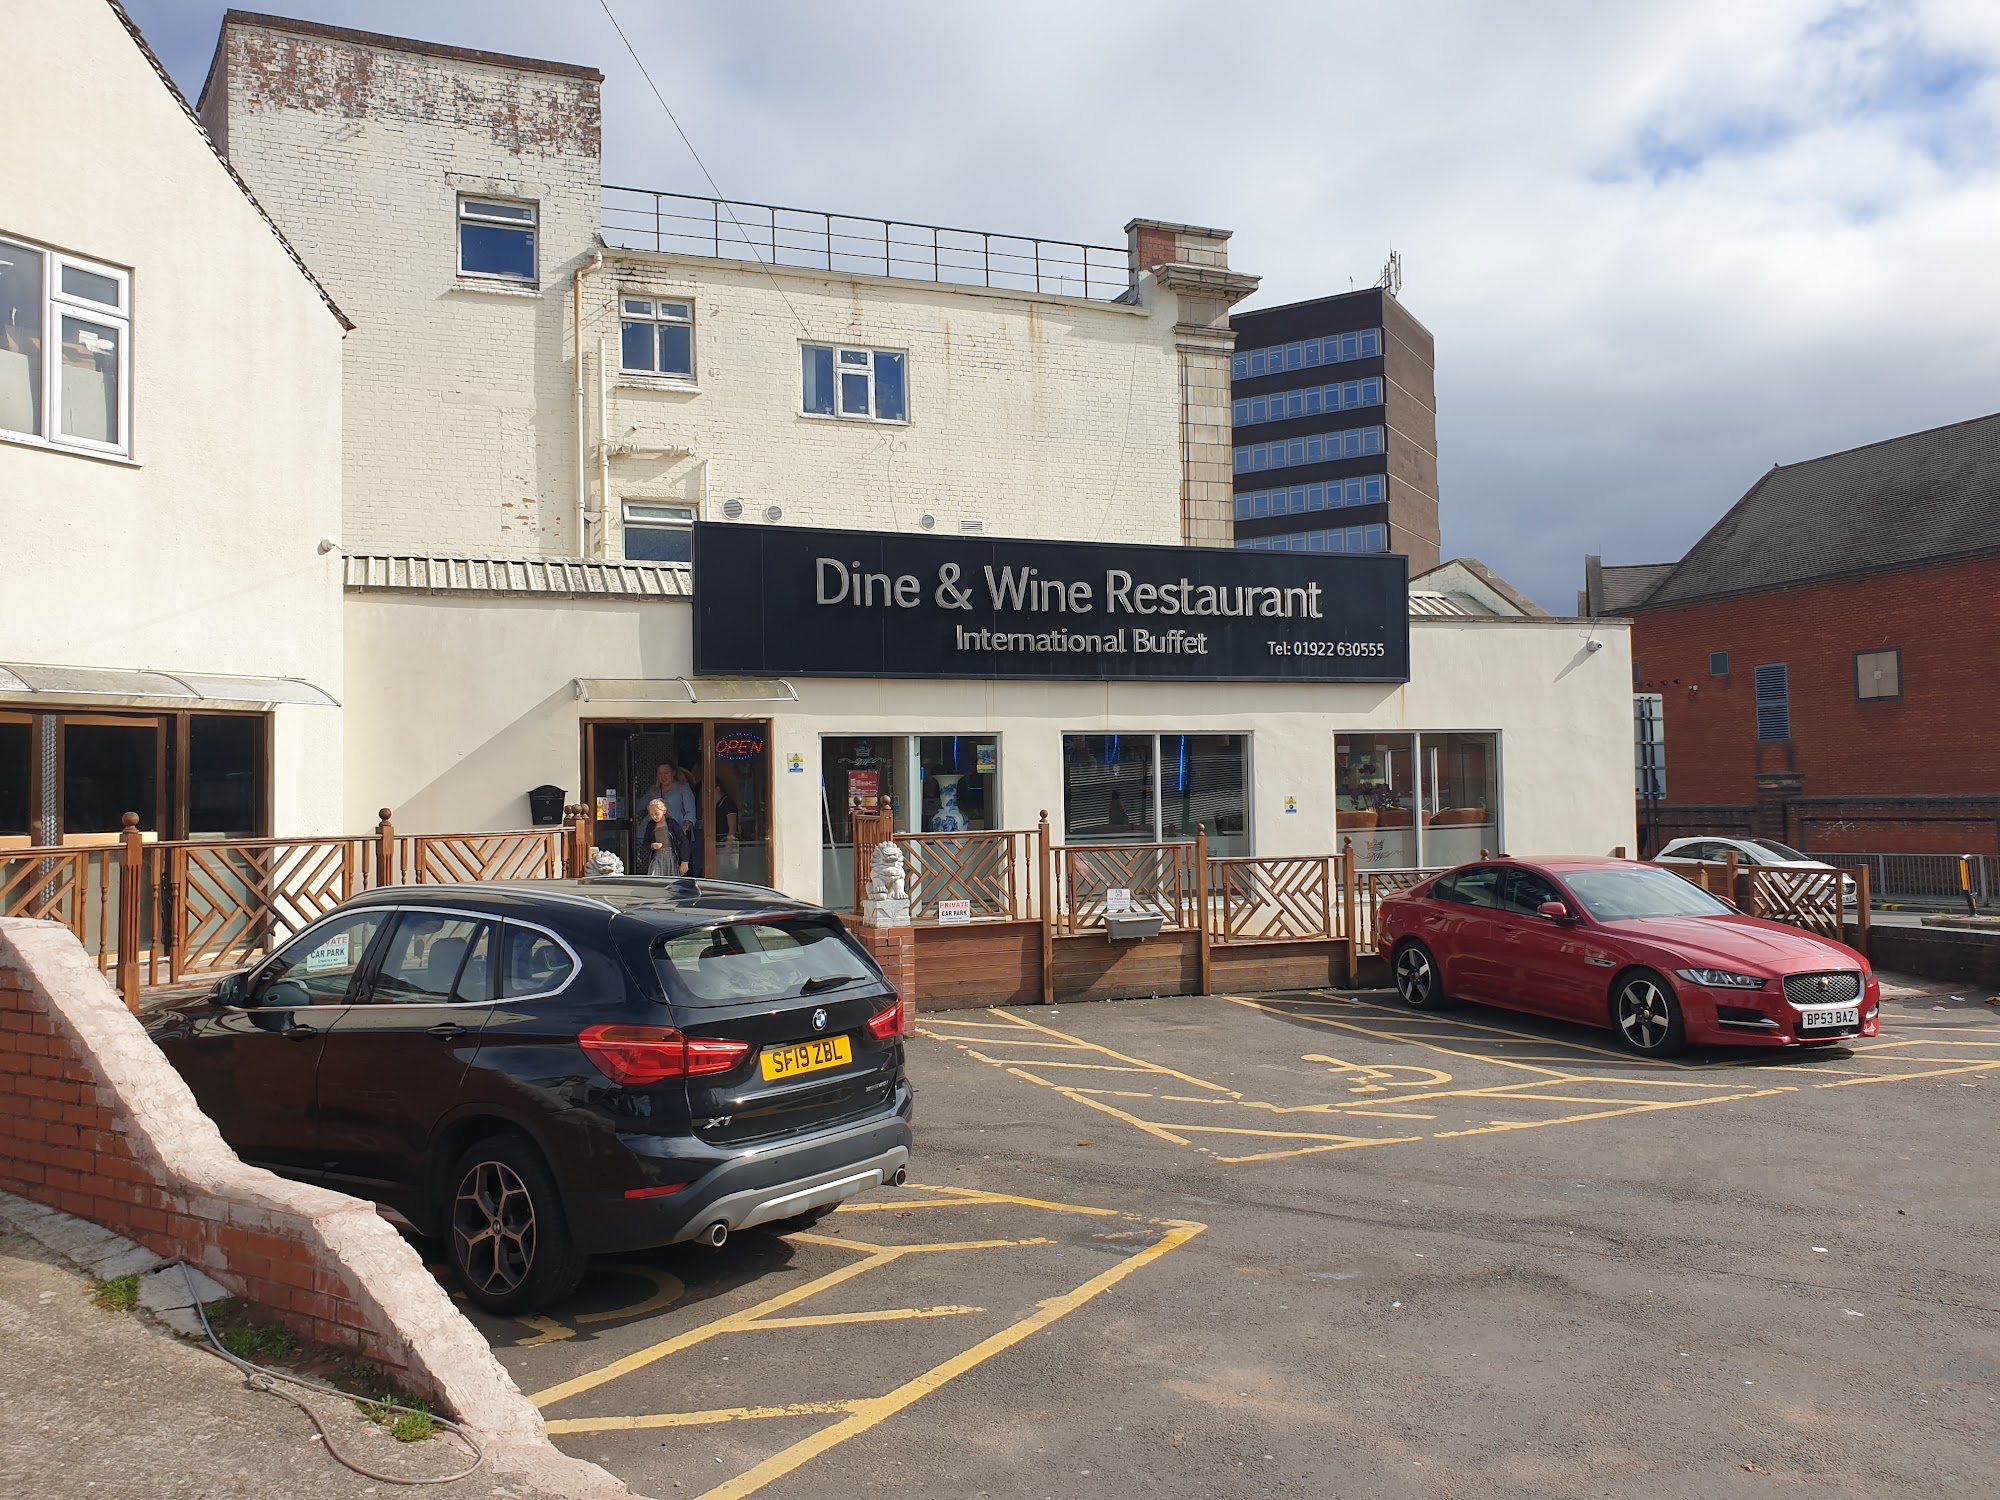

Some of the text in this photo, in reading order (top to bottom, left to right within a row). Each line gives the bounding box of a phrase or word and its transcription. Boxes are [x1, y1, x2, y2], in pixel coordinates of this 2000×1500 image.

[815, 556, 1324, 619] Dine & Wine Restaurant
[956, 624, 1209, 655] International Buffet
[1266, 640, 1385, 657] Tel: 01922 630555
[716, 739, 764, 754] OPEN
[940, 901, 969, 909] PRIVATE
[310, 948, 345, 958] CAR PARK
[1807, 1010, 1855, 1026] BP53 BAZ
[772, 1040, 843, 1073] SF19 ZBL
[703, 1115, 733, 1129] X1
